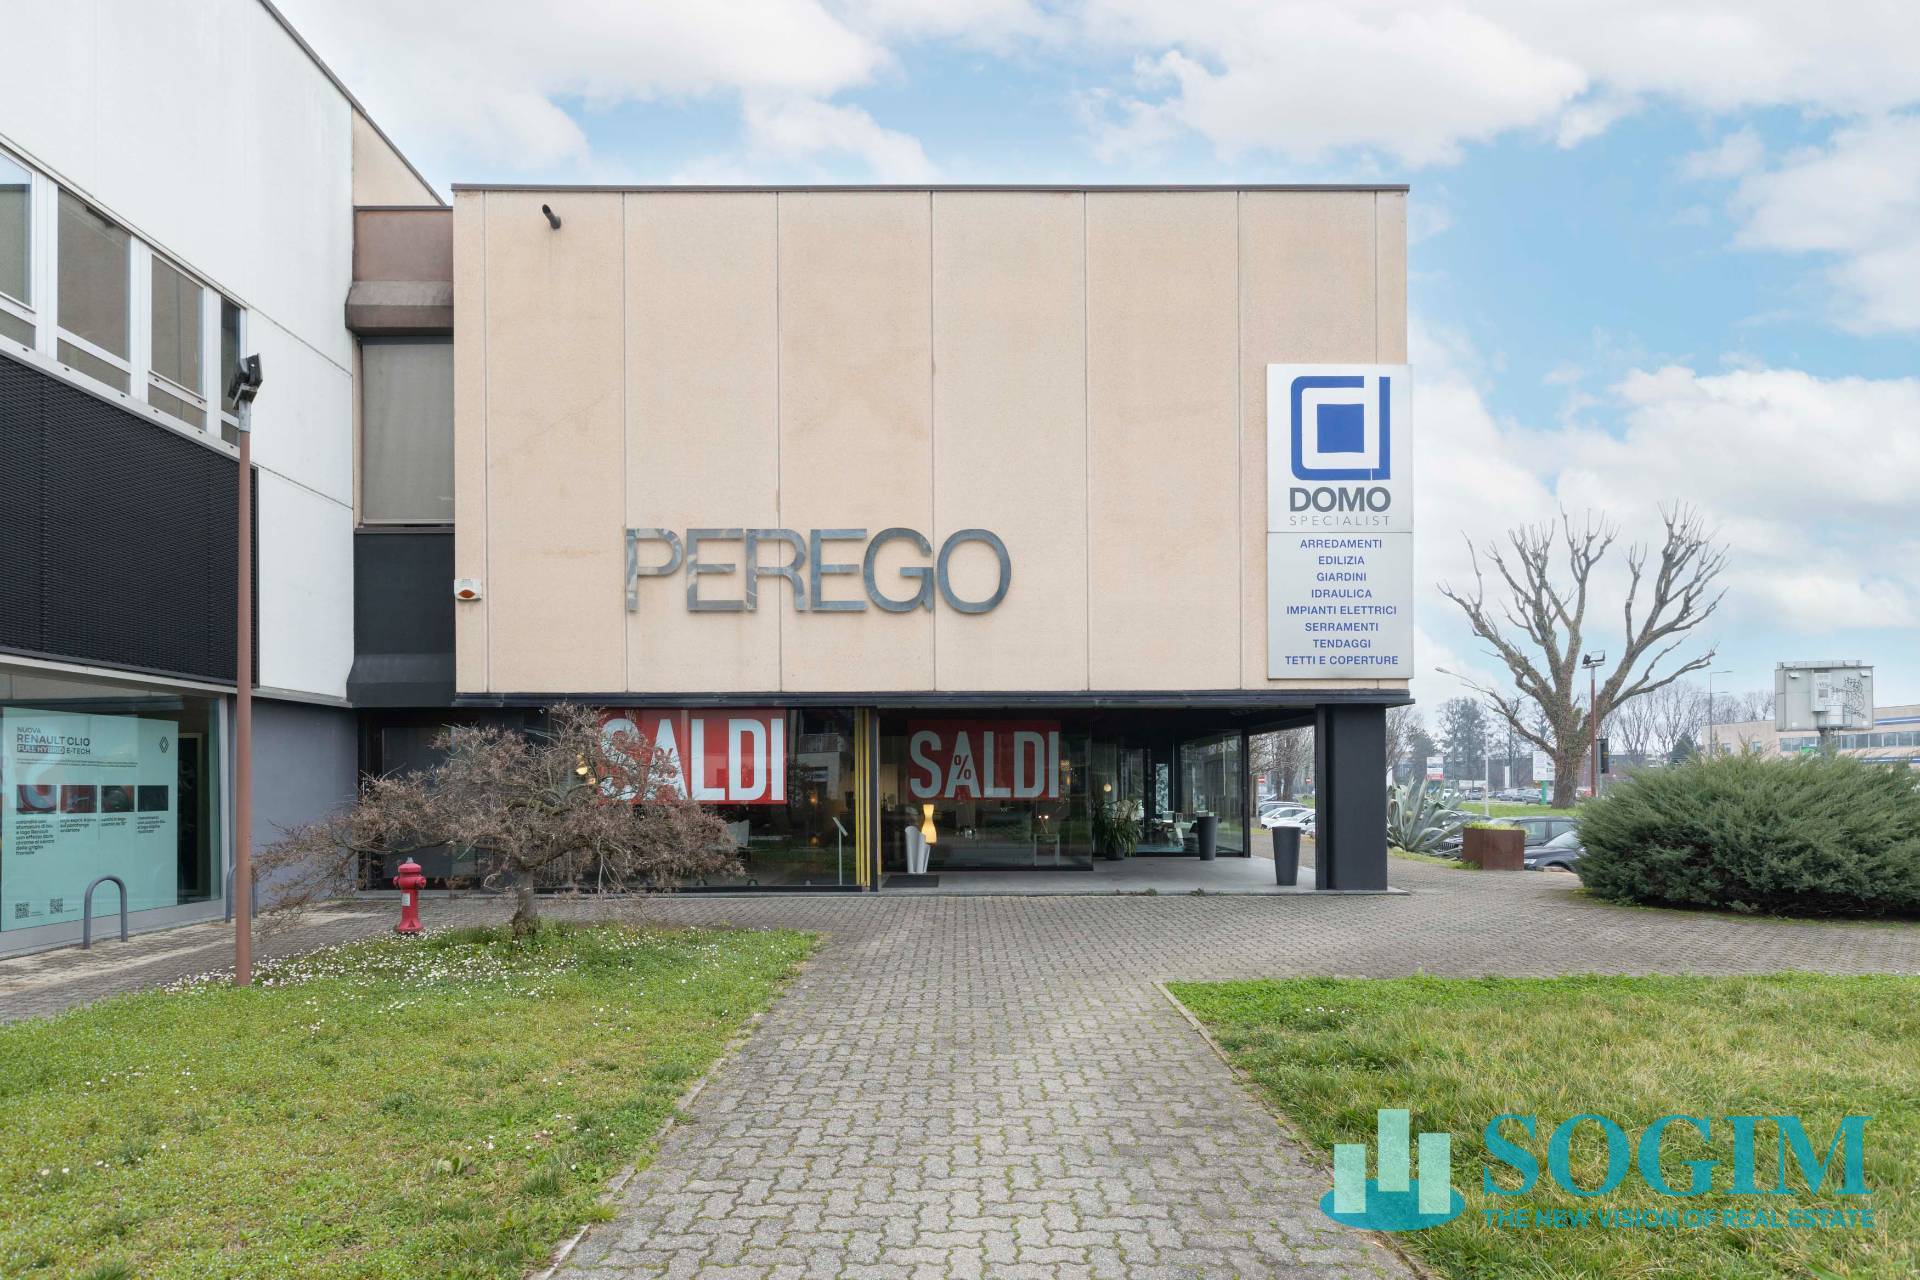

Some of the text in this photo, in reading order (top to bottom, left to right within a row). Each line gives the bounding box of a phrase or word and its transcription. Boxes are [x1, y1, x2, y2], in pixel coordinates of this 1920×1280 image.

[1289, 487, 1392, 513] DOMO
[1289, 515, 1392, 526] SPECIALIST
[1300, 539, 1382, 549] ARREDAMENTI
[1318, 555, 1365, 565] EDILIZIA
[625, 527, 1012, 614] PEREGO
[1316, 572, 1367, 582] GIARDINI
[1311, 589, 1372, 598] IDRAULICA
[1286, 605, 1397, 615] IMPIANTI ELETTRICI
[1304, 622, 1379, 632] SERRAMENTI
[1312, 639, 1371, 648] TENDAGGI
[1285, 655, 1398, 665] TETTI E COPERTURE
[16, 733, 91, 747] RENAULT CLIO
[66, 747, 91, 755] E-TECH
[600, 718, 784, 801] SALDI
[910, 730, 1060, 799] SALDI
